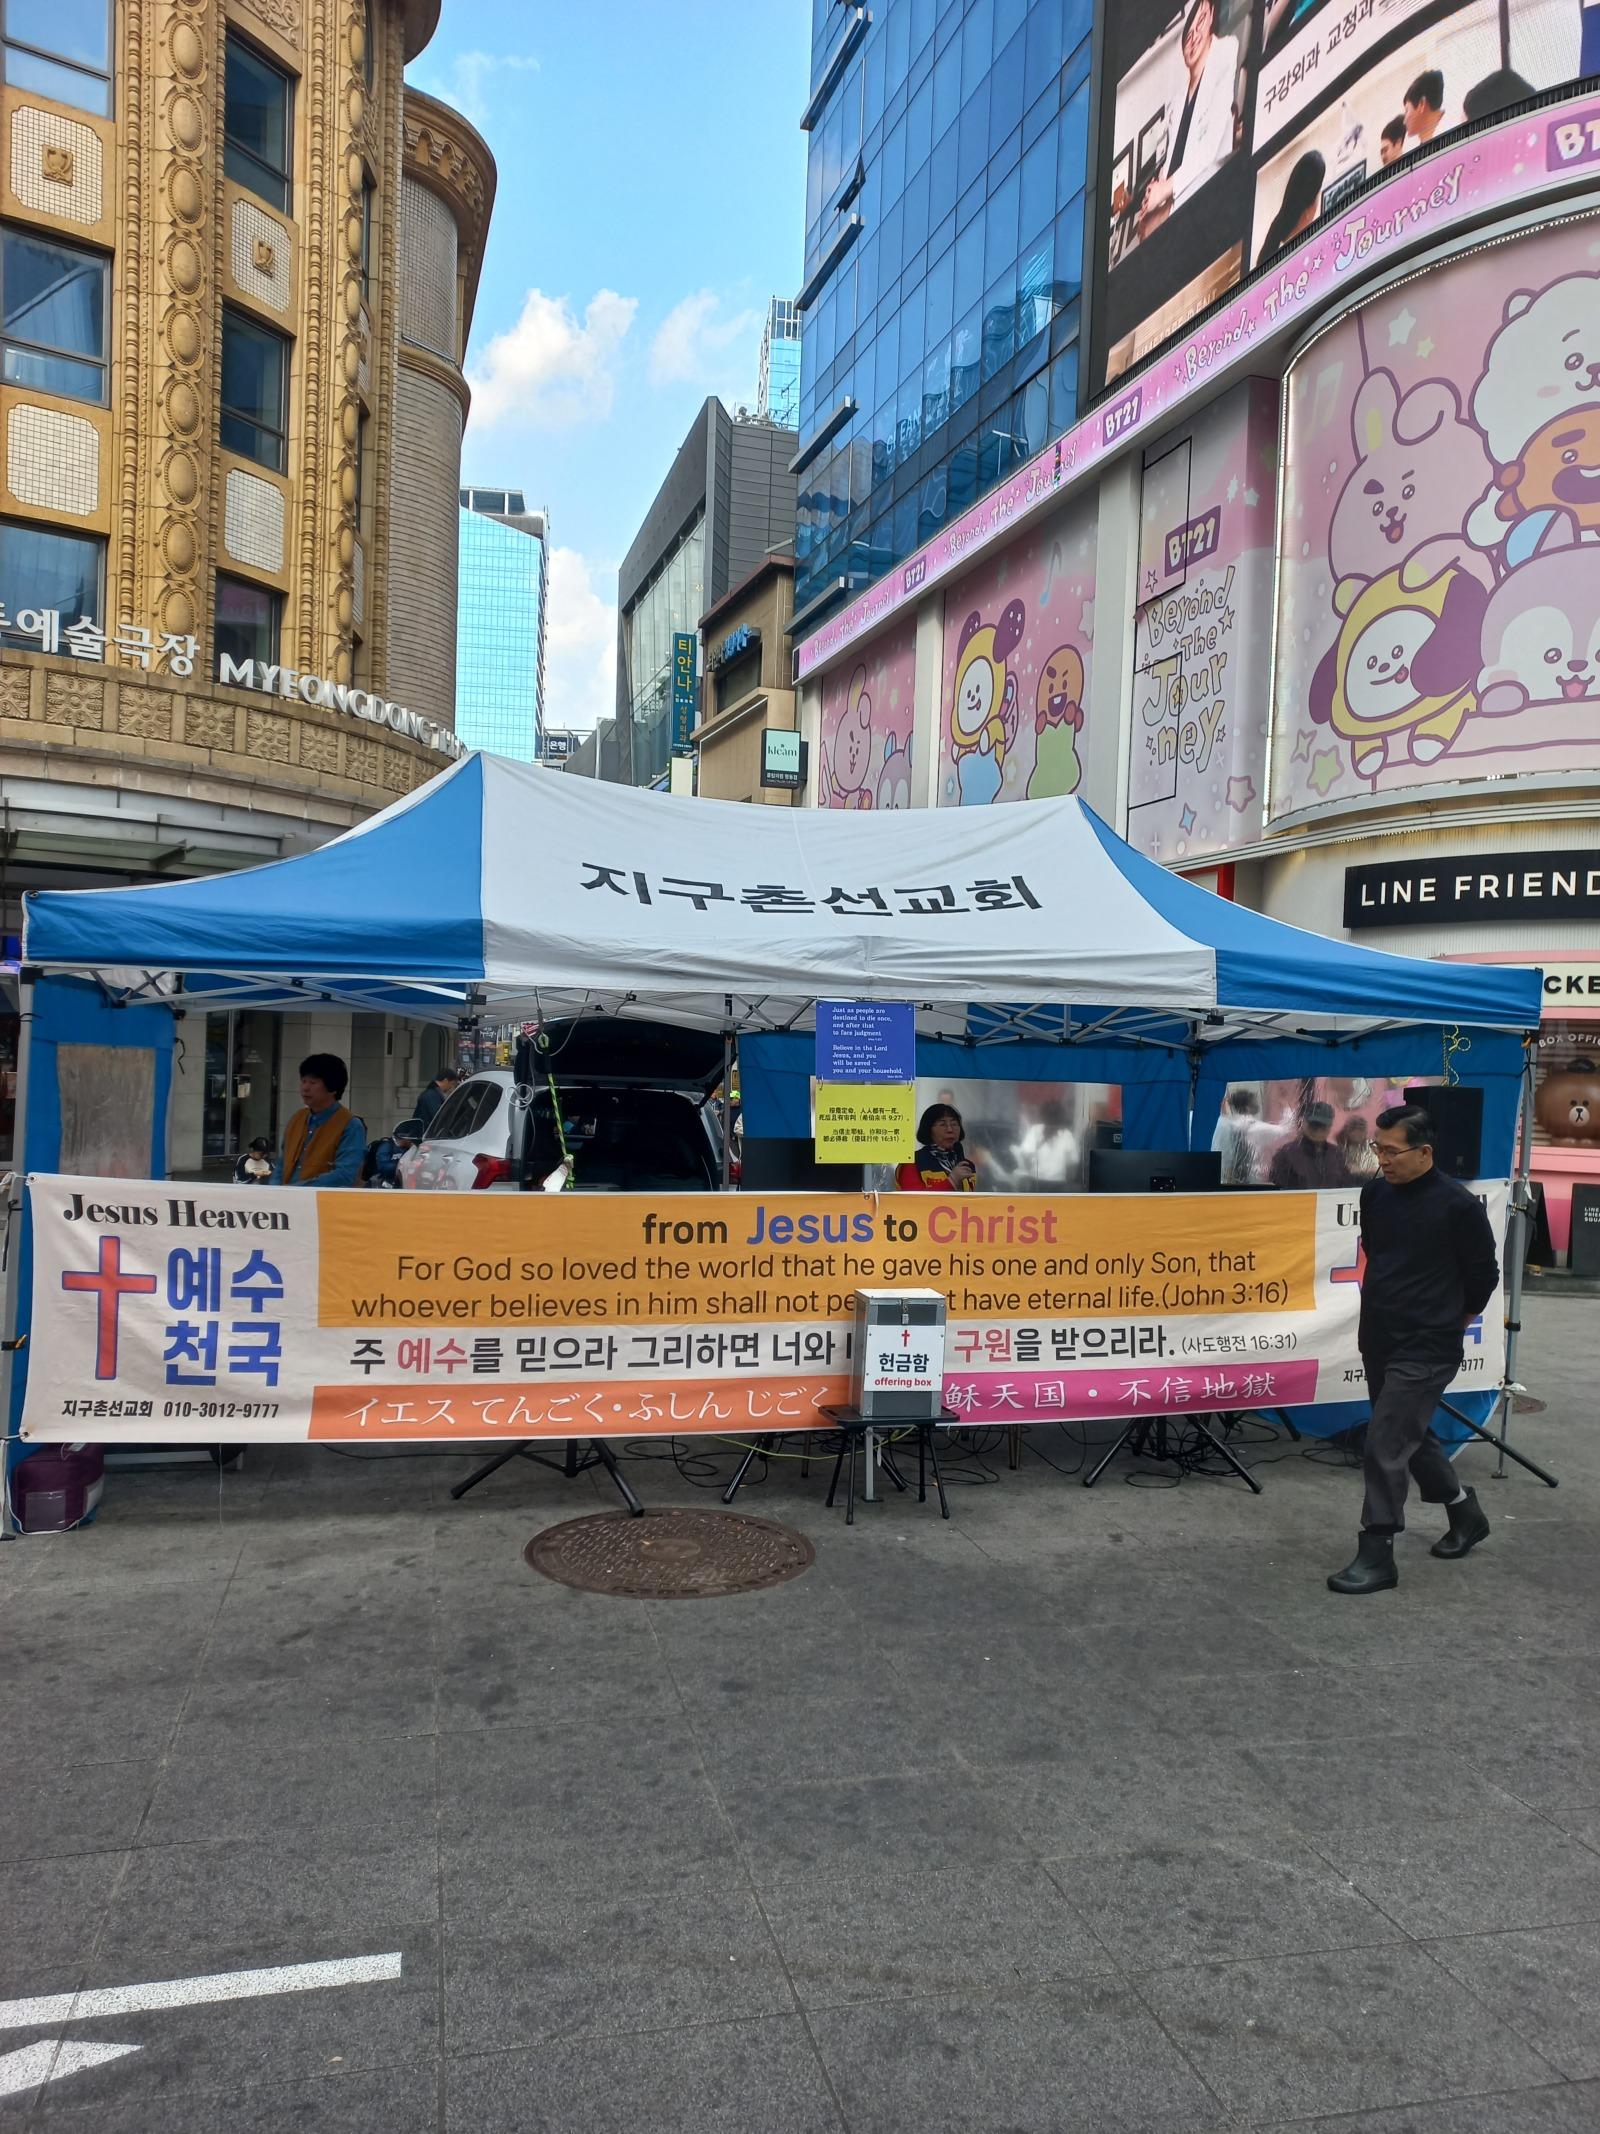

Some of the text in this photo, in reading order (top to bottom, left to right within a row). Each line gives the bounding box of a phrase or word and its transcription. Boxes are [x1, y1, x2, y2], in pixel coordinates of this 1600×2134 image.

[1264, 0, 1375, 113] 구강외과 교정과
[1185, 309, 1247, 381] Beyond
[1264, 268, 1309, 321] The
[1334, 163, 1463, 272] Journey
[1105, 396, 1139, 439] BT21
[1169, 517, 1216, 567] BT21
[1144, 565, 1235, 647] Beyond
[0, 602, 200, 676] 예술극장
[1181, 626, 1217, 661] The
[677, 639, 693, 692] 티안나
[1142, 652, 1227, 726] Jour
[219, 652, 432, 744] MYEONGDONG
[1158, 700, 1225, 774] ney
[580, 862, 1043, 916] 지구촌선교회
[1361, 878, 1437, 907] LINE
[1568, 1033, 1600, 1046] OFFI
[63, 1193, 291, 1231] Jesus Heaven
[642, 1205, 1058, 1245] from Jesus to Christ
[167, 1247, 284, 1313] 예수
[398, 1250, 1256, 1281] For God so loved the world that he gave his one and only Son, that
[352, 1293, 481, 1318] whoever
[490, 1293, 608, 1318] believes
[616, 1292, 640, 1316] in
[648, 1291, 698, 1315] him
[706, 1290, 767, 1315] shall
[776, 1290, 819, 1313] not
[964, 1288, 1021, 1311] have
[1027, 1286, 1112, 1310] eternal
[1231, 1278, 1289, 1306] 3:16)
[163, 1320, 282, 1387] 천국
[350, 1339, 386, 1374] 주
[397, 1337, 504, 1374] 예수를
[516, 1334, 618, 1373] 믿으라
[627, 1332, 760, 1369] 그리하면
[772, 1330, 836, 1366] 너와
[954, 1327, 1042, 1363] 구원을
[1051, 1325, 1176, 1361] 받으리라.
[1181, 1335, 1248, 1357] (사도행전
[1250, 1331, 1298, 1353] 16:31)
[878, 1353, 930, 1373] 헌금함
[874, 1377, 932, 1387] offering box
[61, 1400, 280, 1419] 지구촌선교회 010-3012-9777
[344, 1397, 457, 1428] イエス
